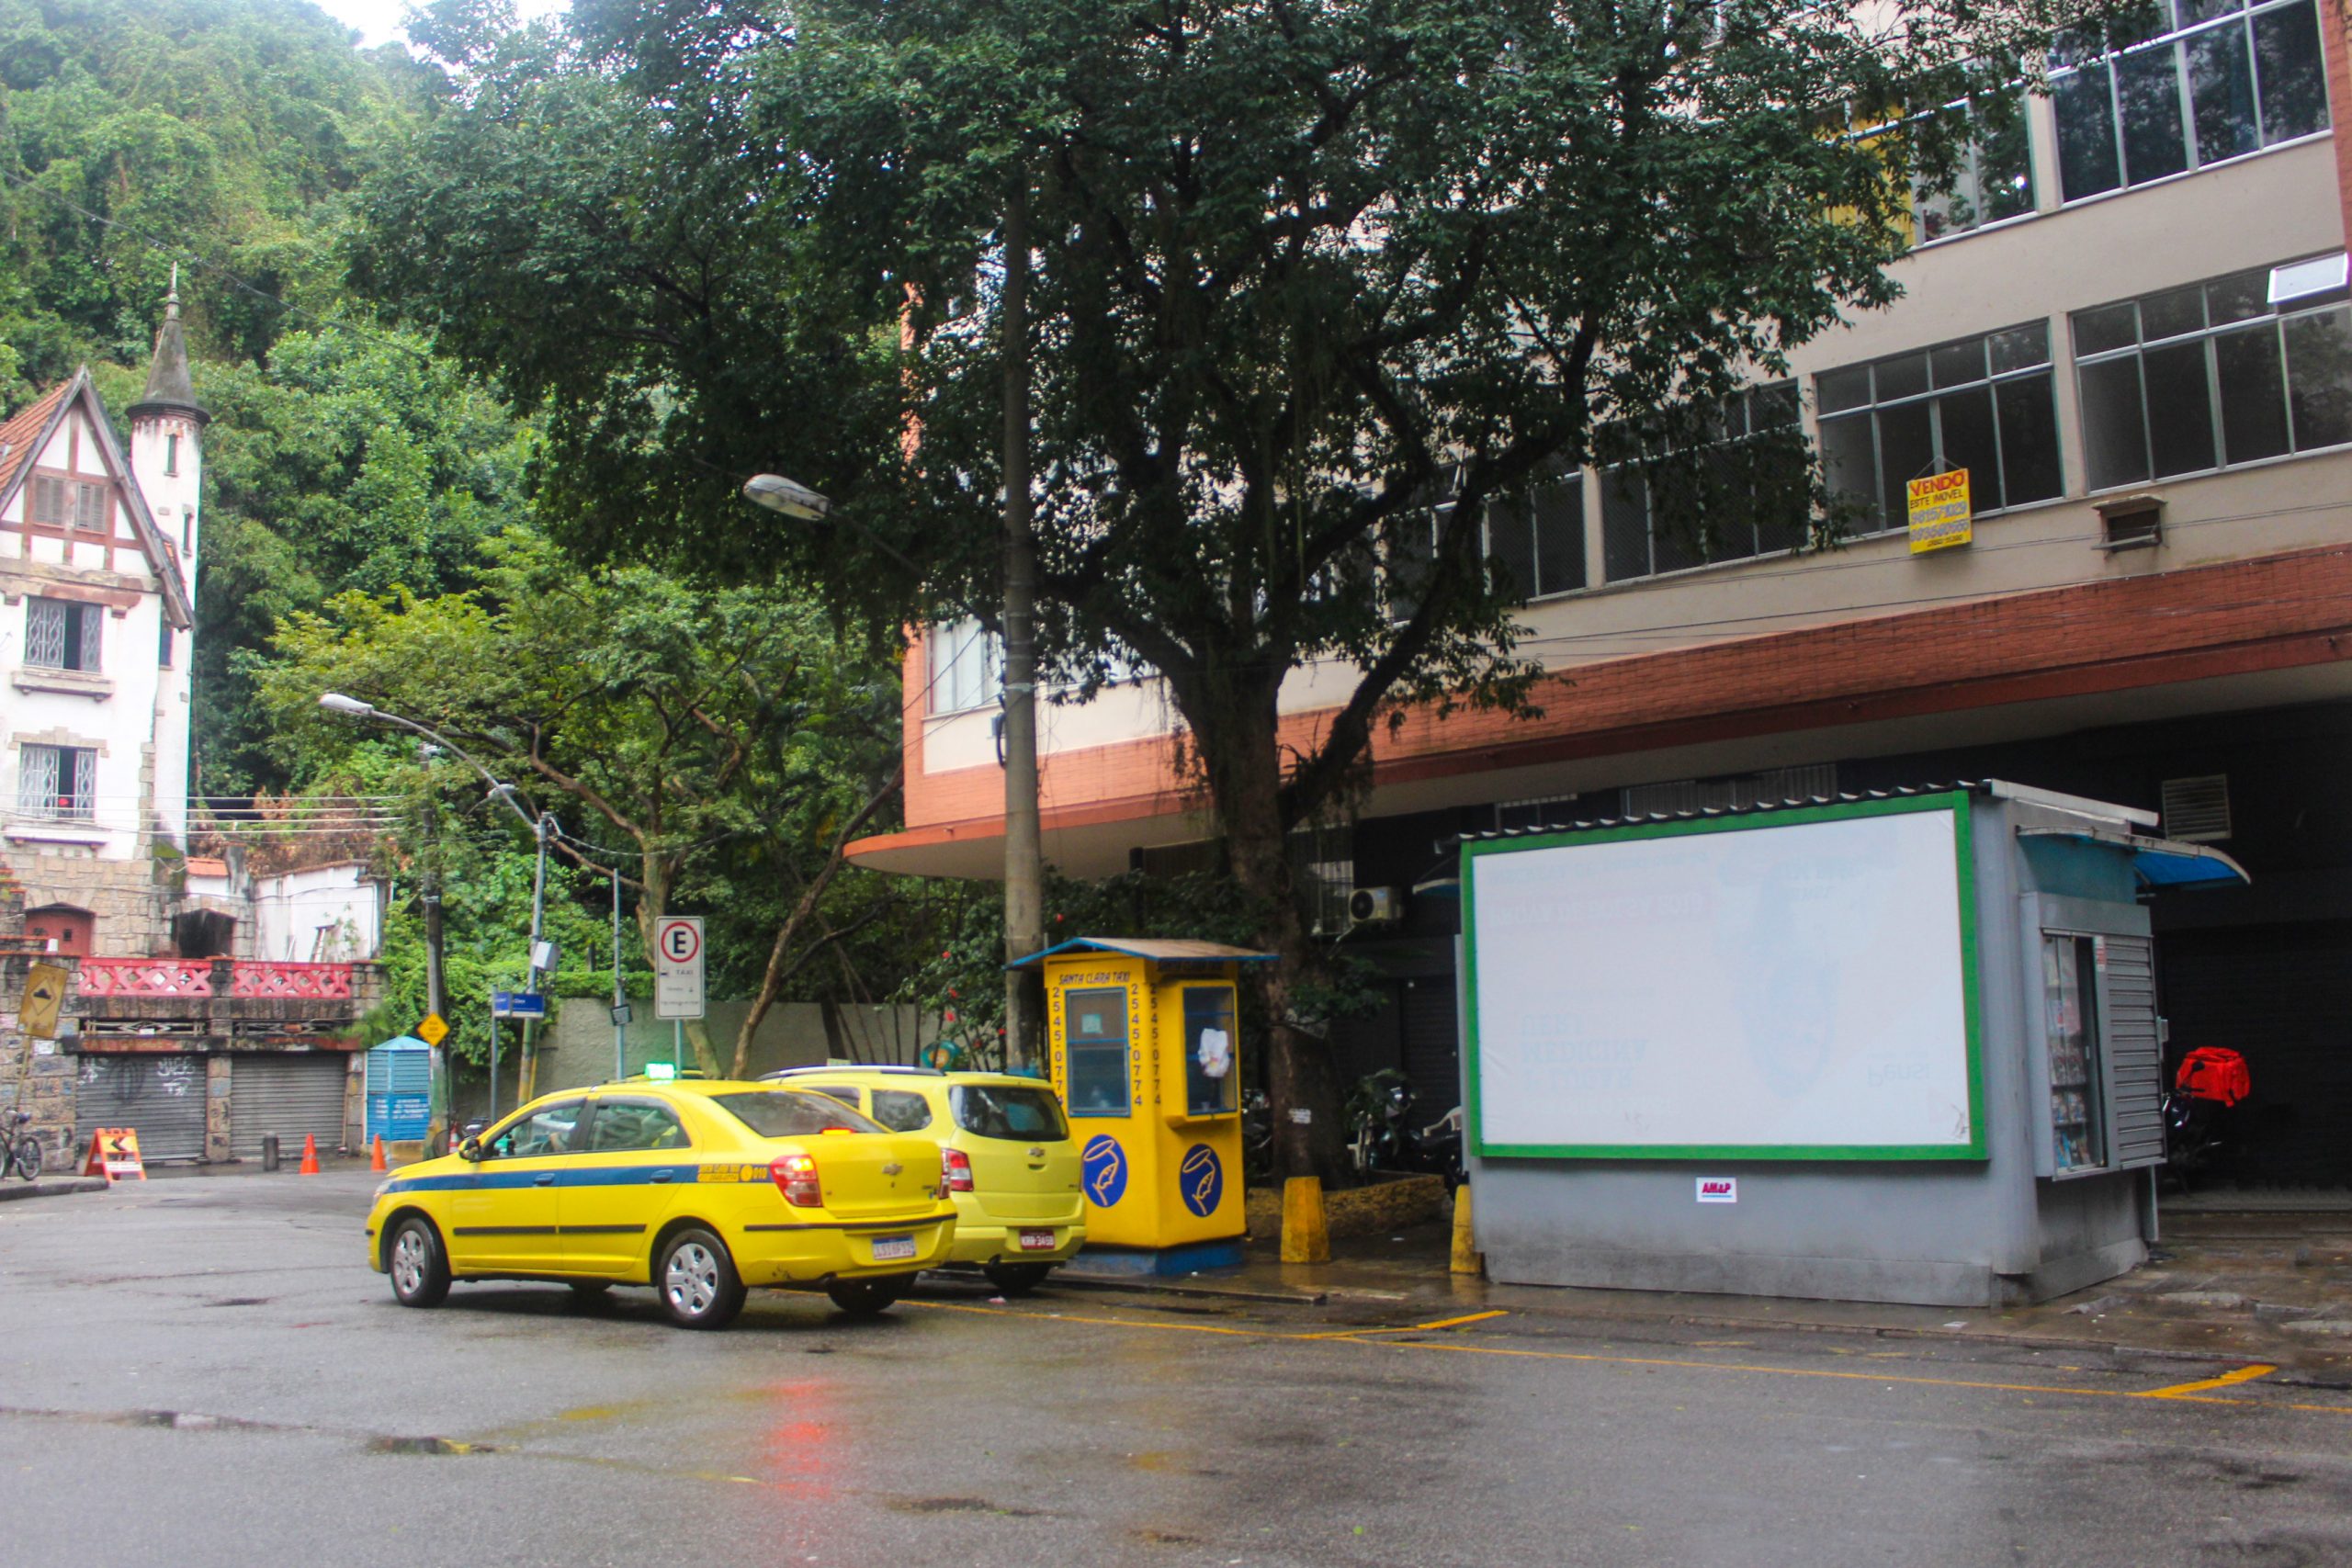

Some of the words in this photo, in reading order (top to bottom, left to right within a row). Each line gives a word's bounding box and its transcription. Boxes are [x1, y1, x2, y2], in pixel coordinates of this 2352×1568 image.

[1909, 472, 1966, 496] VENDO
[1909, 496, 1930, 509] ESTE
[673, 931, 686, 953] E
[1059, 973, 1083, 986] SANTA
[1086, 972, 1111, 984] CLARA
[1113, 971, 1131, 983] TAXI
[1702, 1182, 1732, 1194] AM&P
